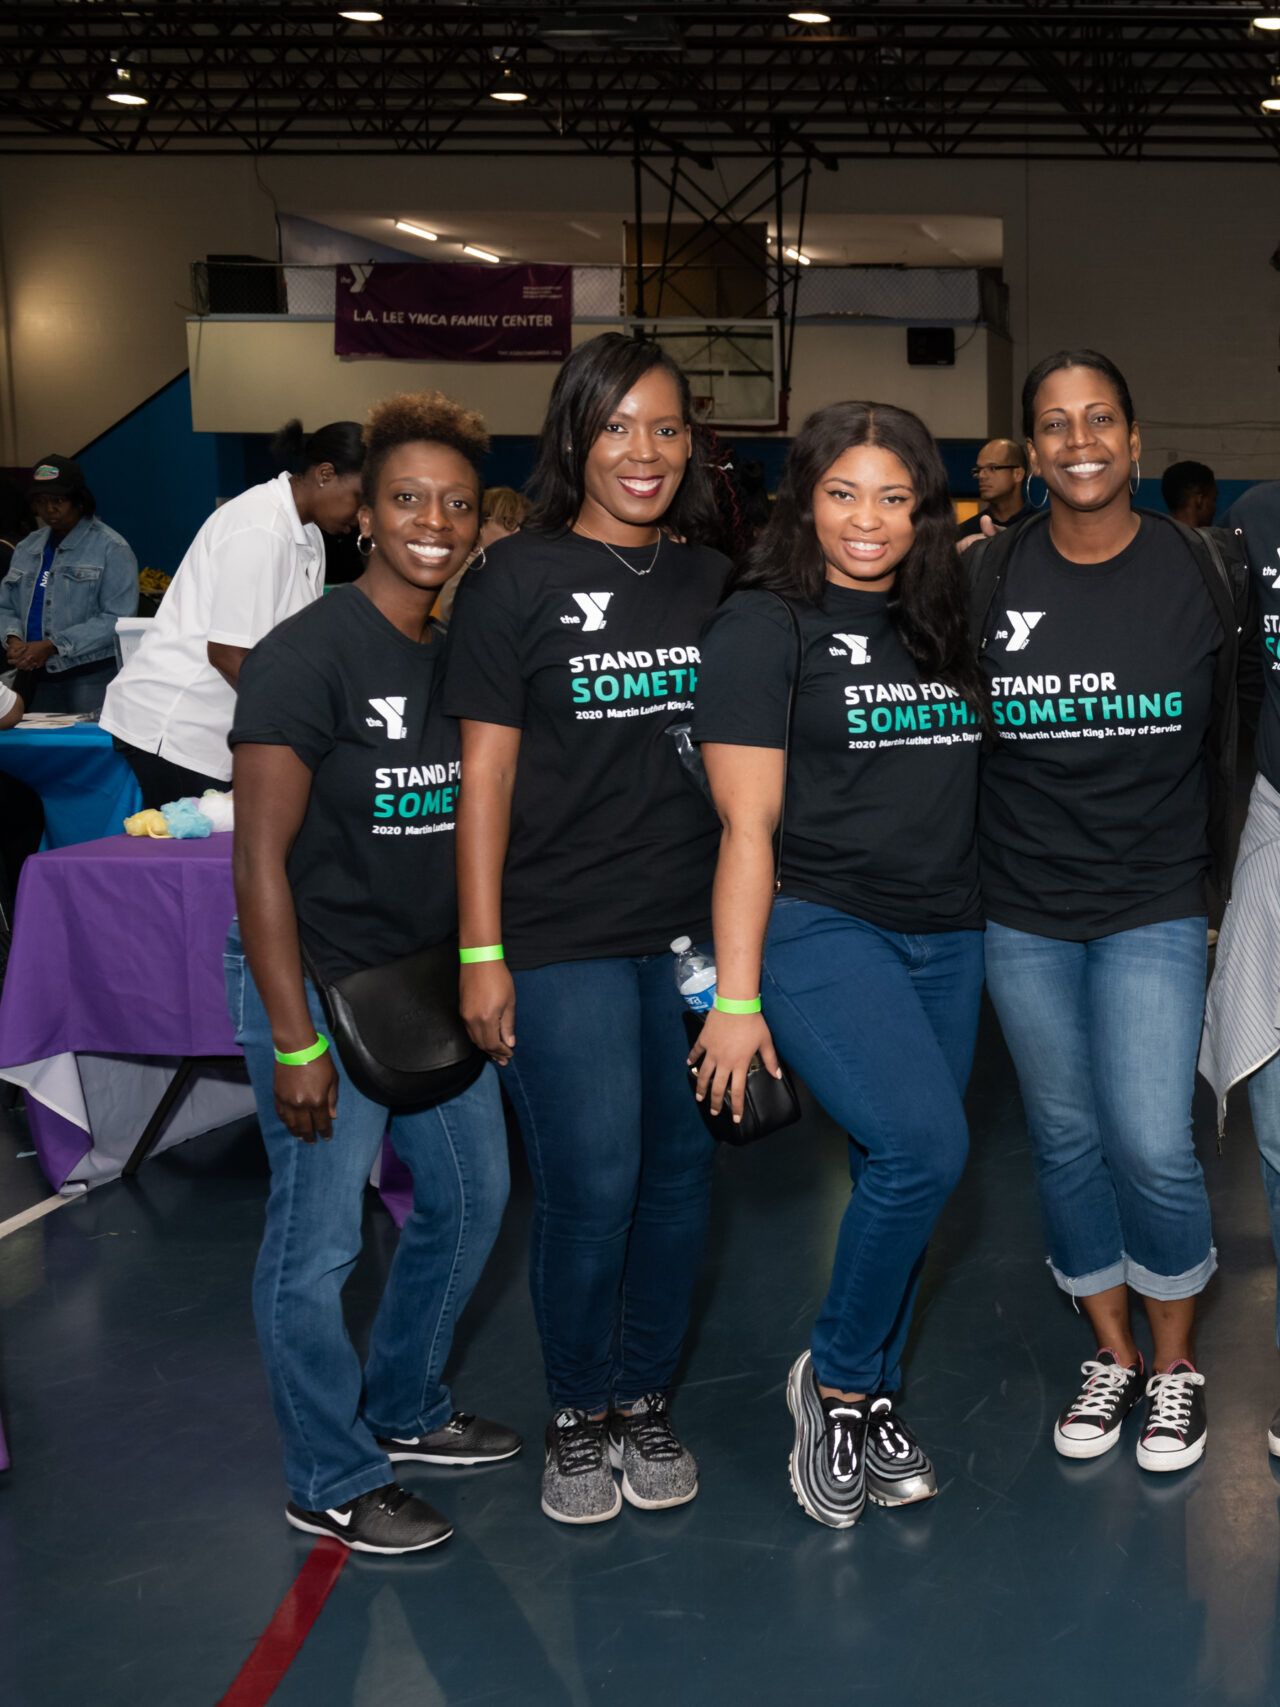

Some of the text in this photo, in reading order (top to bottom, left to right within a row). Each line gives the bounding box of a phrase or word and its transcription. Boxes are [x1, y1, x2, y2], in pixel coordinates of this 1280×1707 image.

[354, 310, 552, 327] L.A. LEE YMCA FAMILY CENTER
[1262, 566, 1277, 576] the
[560, 592, 611, 631] the Y
[995, 630, 1008, 640] he
[1005, 610, 1043, 651] Y
[569, 646, 701, 673] STAND FOR
[829, 647, 848, 656] the
[844, 683, 917, 705] STAND
[991, 672, 1117, 697] STAND FOR
[575, 710, 603, 720] 2020
[607, 707, 639, 718] Martin
[640, 703, 667, 715] Luther
[667, 701, 684, 712] King
[992, 692, 1182, 726] SOMETHING
[366, 717, 383, 727] the
[848, 740, 876, 749] 2020
[879, 738, 905, 748] Martin
[906, 735, 932, 746] Luther
[933, 733, 952, 746] King
[952, 734, 962, 743] Jr.
[1019, 731, 1049, 740] Martin
[1050, 729, 1081, 739] Luther
[1082, 728, 1104, 739] King
[1105, 729, 1116, 738] Jr.
[1118, 726, 1137, 739] Day
[1138, 725, 1149, 735] of
[1150, 724, 1182, 735] Service
[375, 764, 446, 789] STAND
[372, 822, 455, 836] 2020 Martin Luther
